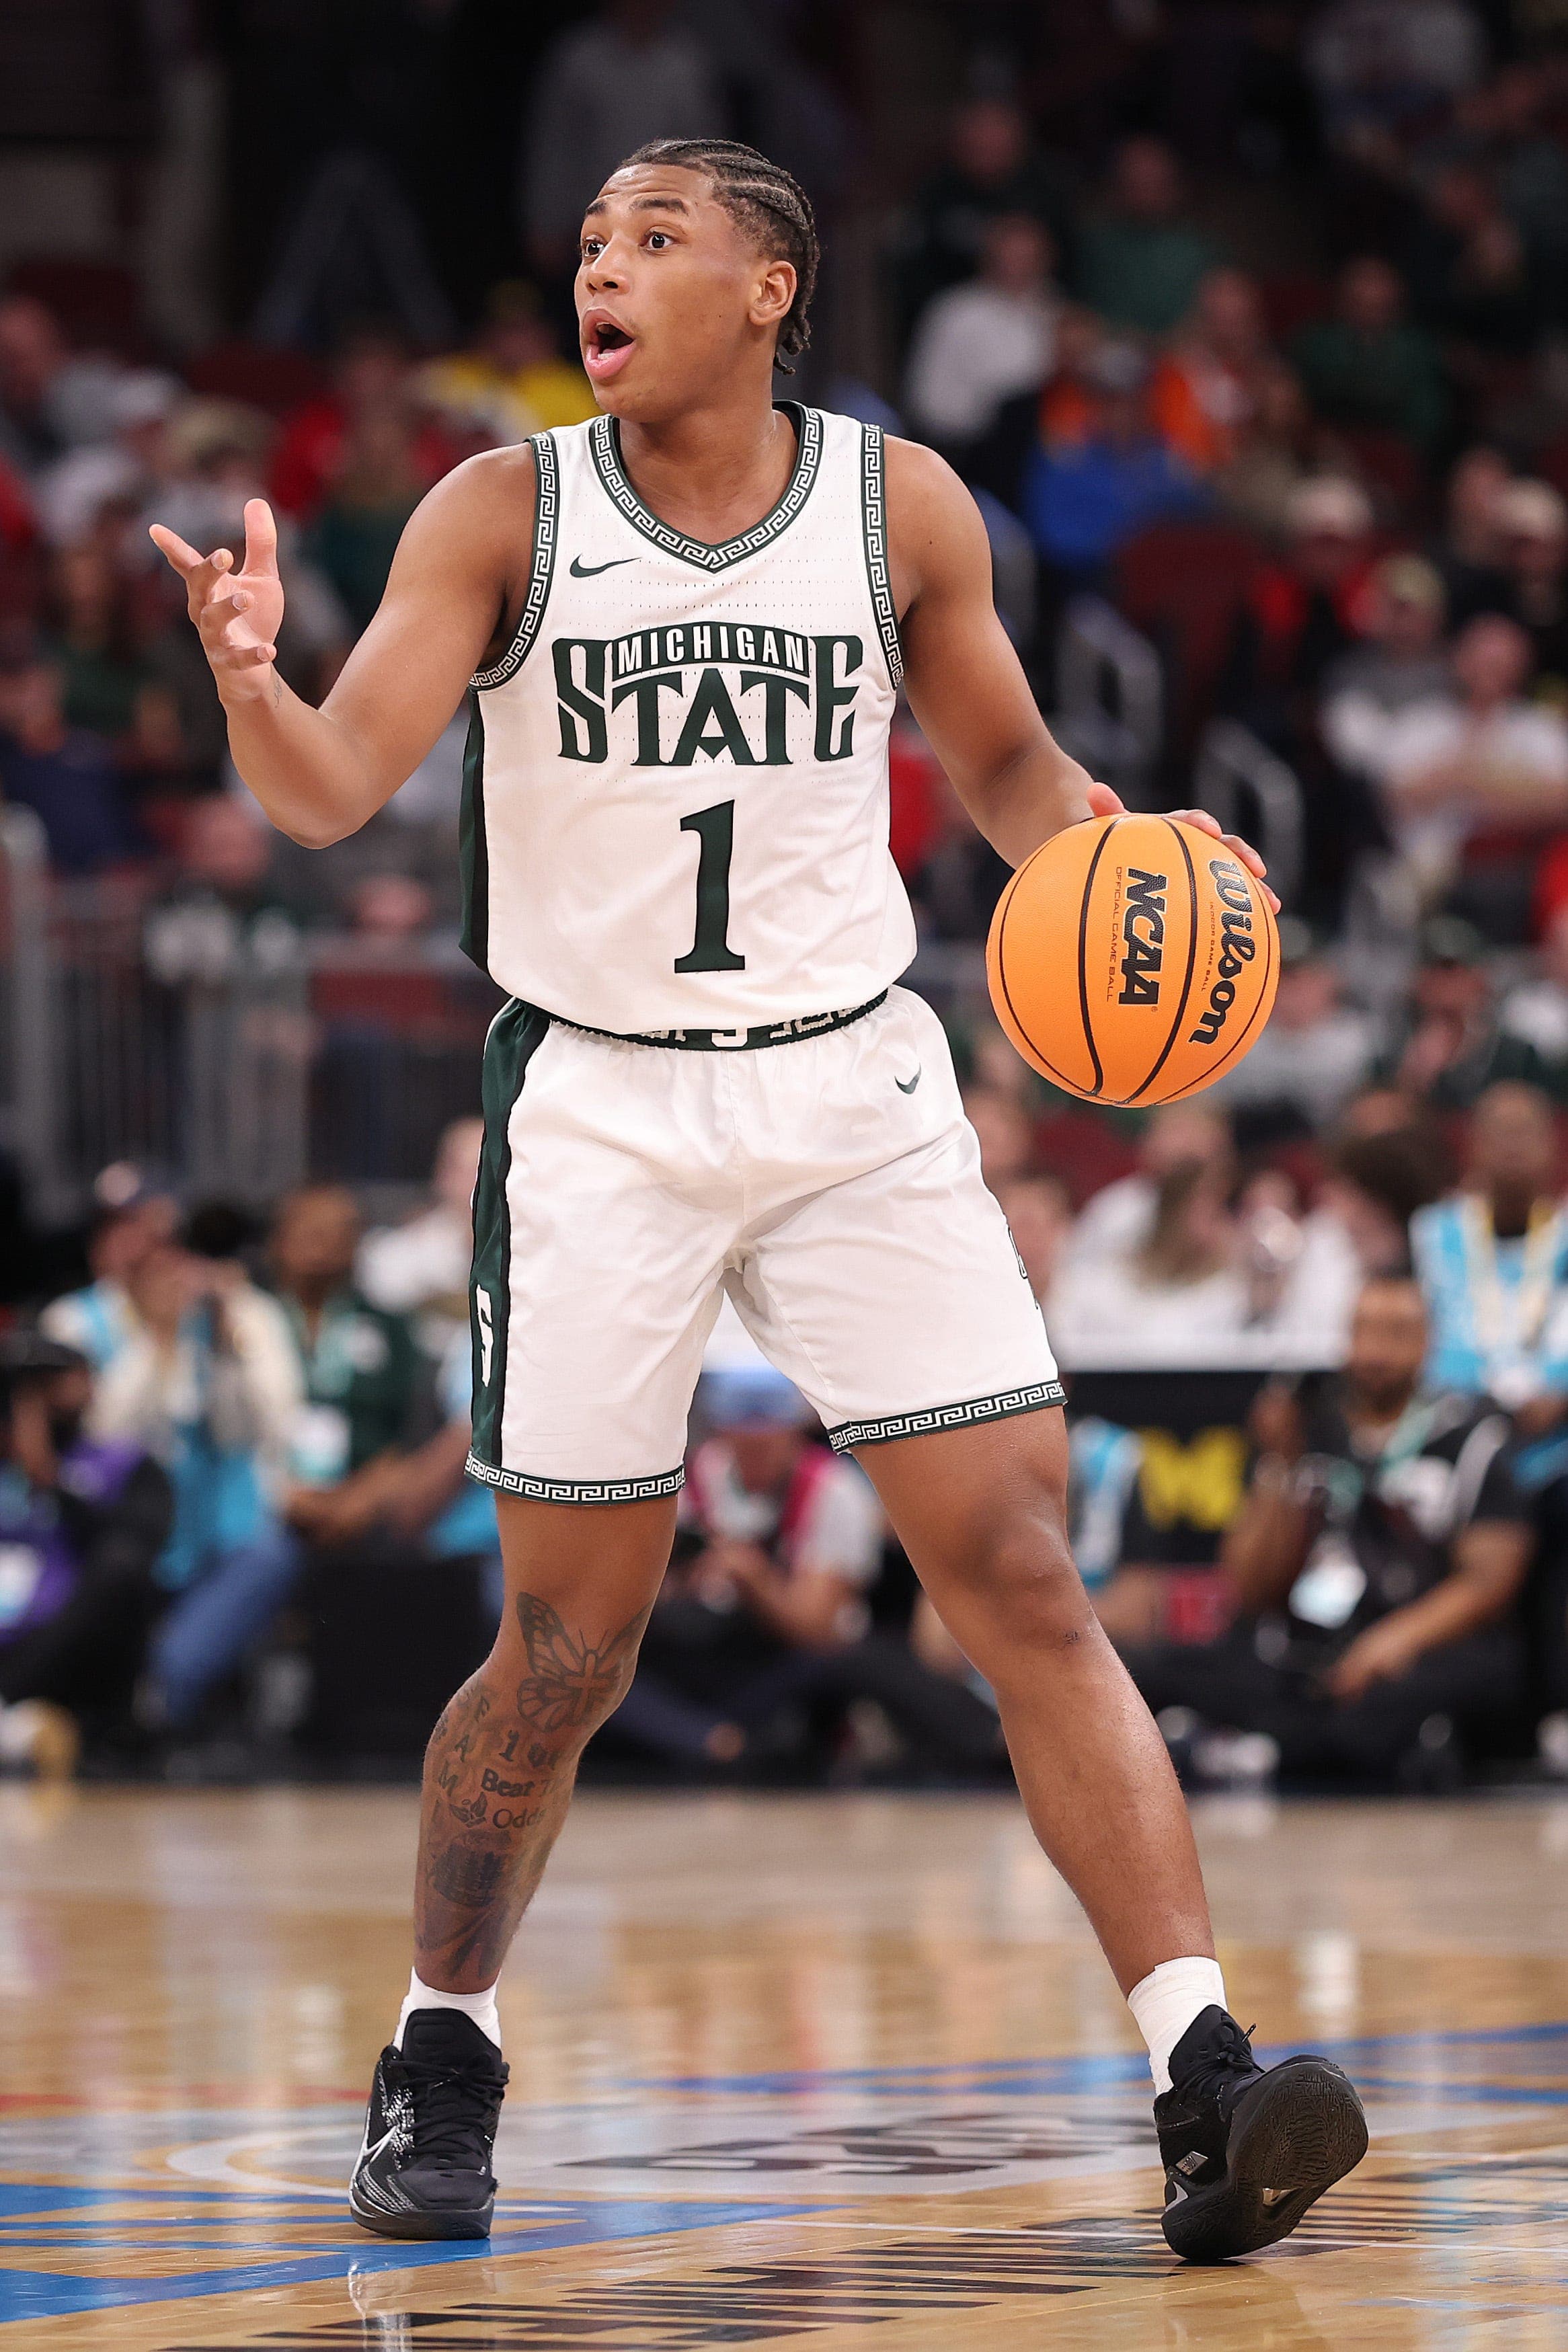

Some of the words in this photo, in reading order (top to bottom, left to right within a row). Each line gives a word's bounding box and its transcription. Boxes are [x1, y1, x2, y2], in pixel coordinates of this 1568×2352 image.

[617, 625, 806, 675] MICHIGAN
[551, 635, 864, 766] STATE
[674, 799, 746, 974] 1
[1112, 867, 1122, 919] OFFICIAL
[1109, 923, 1119, 963] GAME
[1118, 867, 1167, 1005] NCAA
[1188, 860, 1255, 1045] Wilson
[1106, 966, 1115, 1003] BALL
[1201, 969, 1211, 992] BALL
